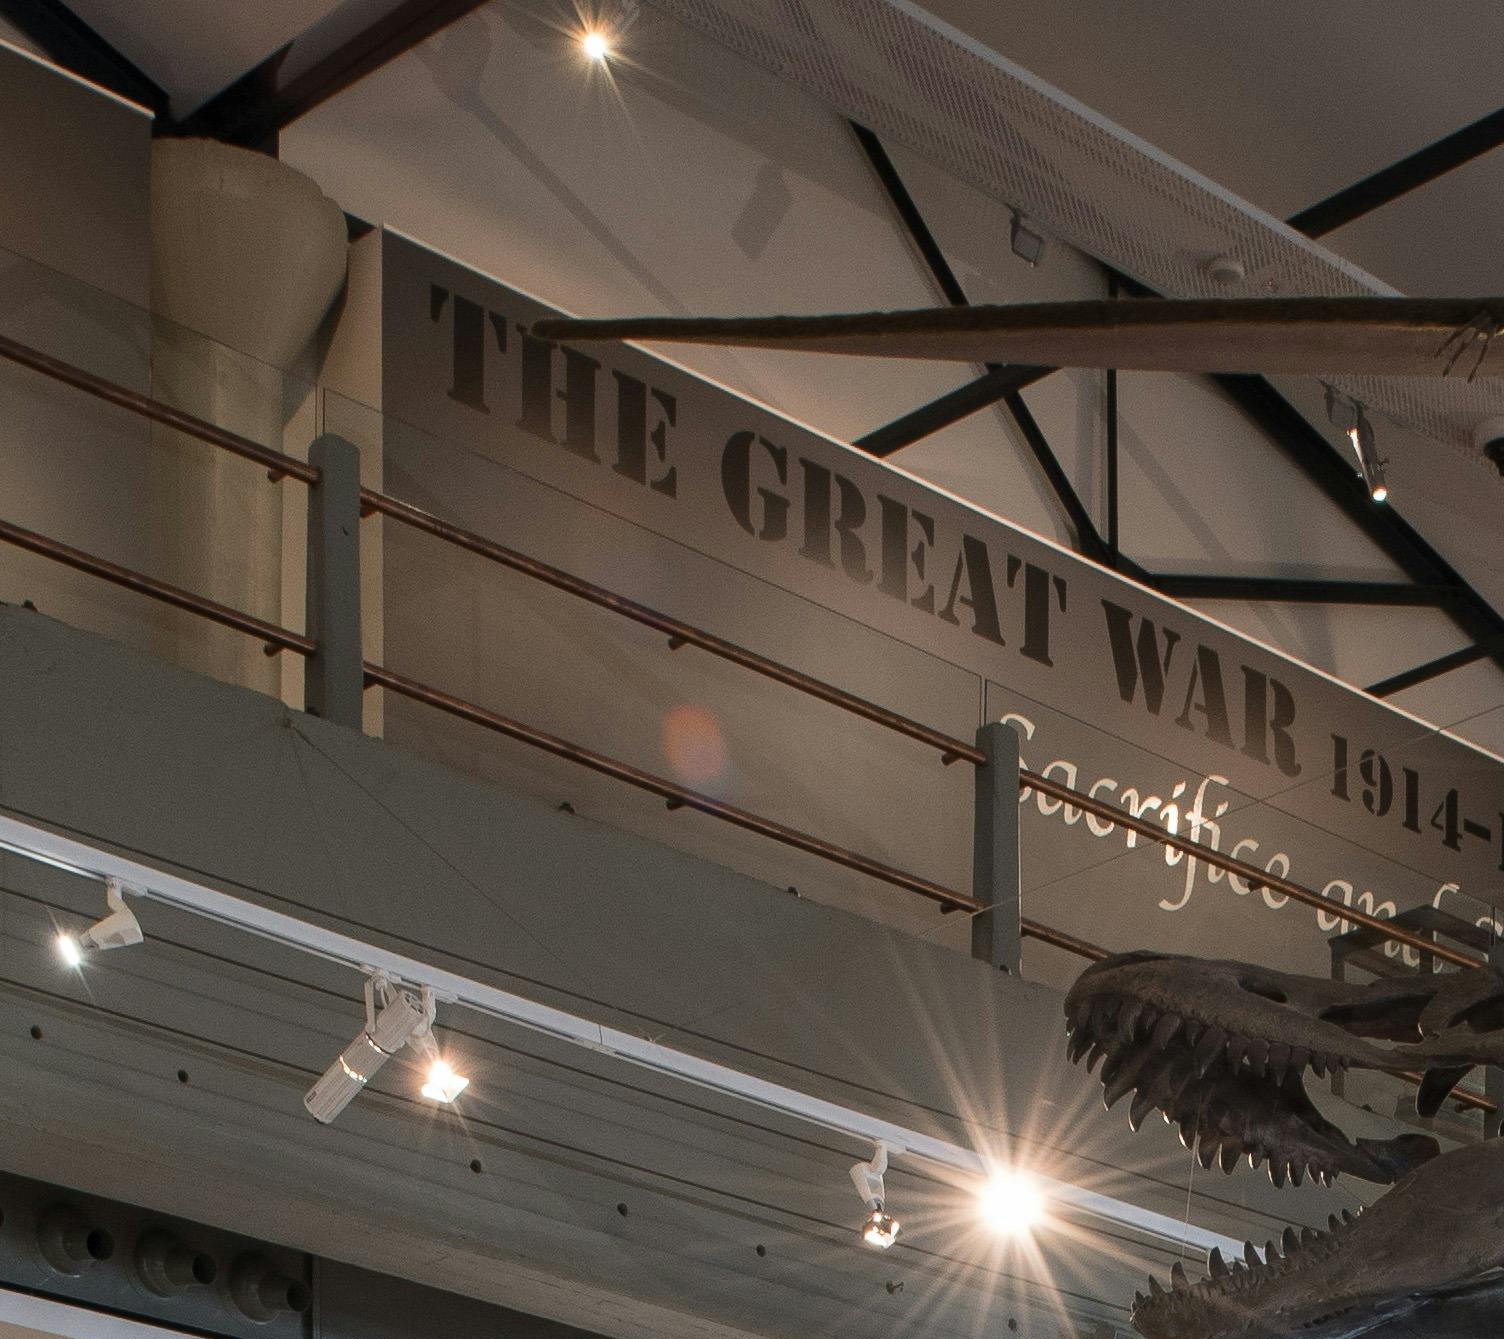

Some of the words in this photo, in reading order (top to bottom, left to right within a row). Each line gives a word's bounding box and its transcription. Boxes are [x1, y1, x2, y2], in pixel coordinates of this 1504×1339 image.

[429, 284, 677, 500] THE
[719, 429, 1068, 667] GREAT
[1101, 600, 1305, 779] WAR
[999, 712, 1292, 911] Sacrifice
